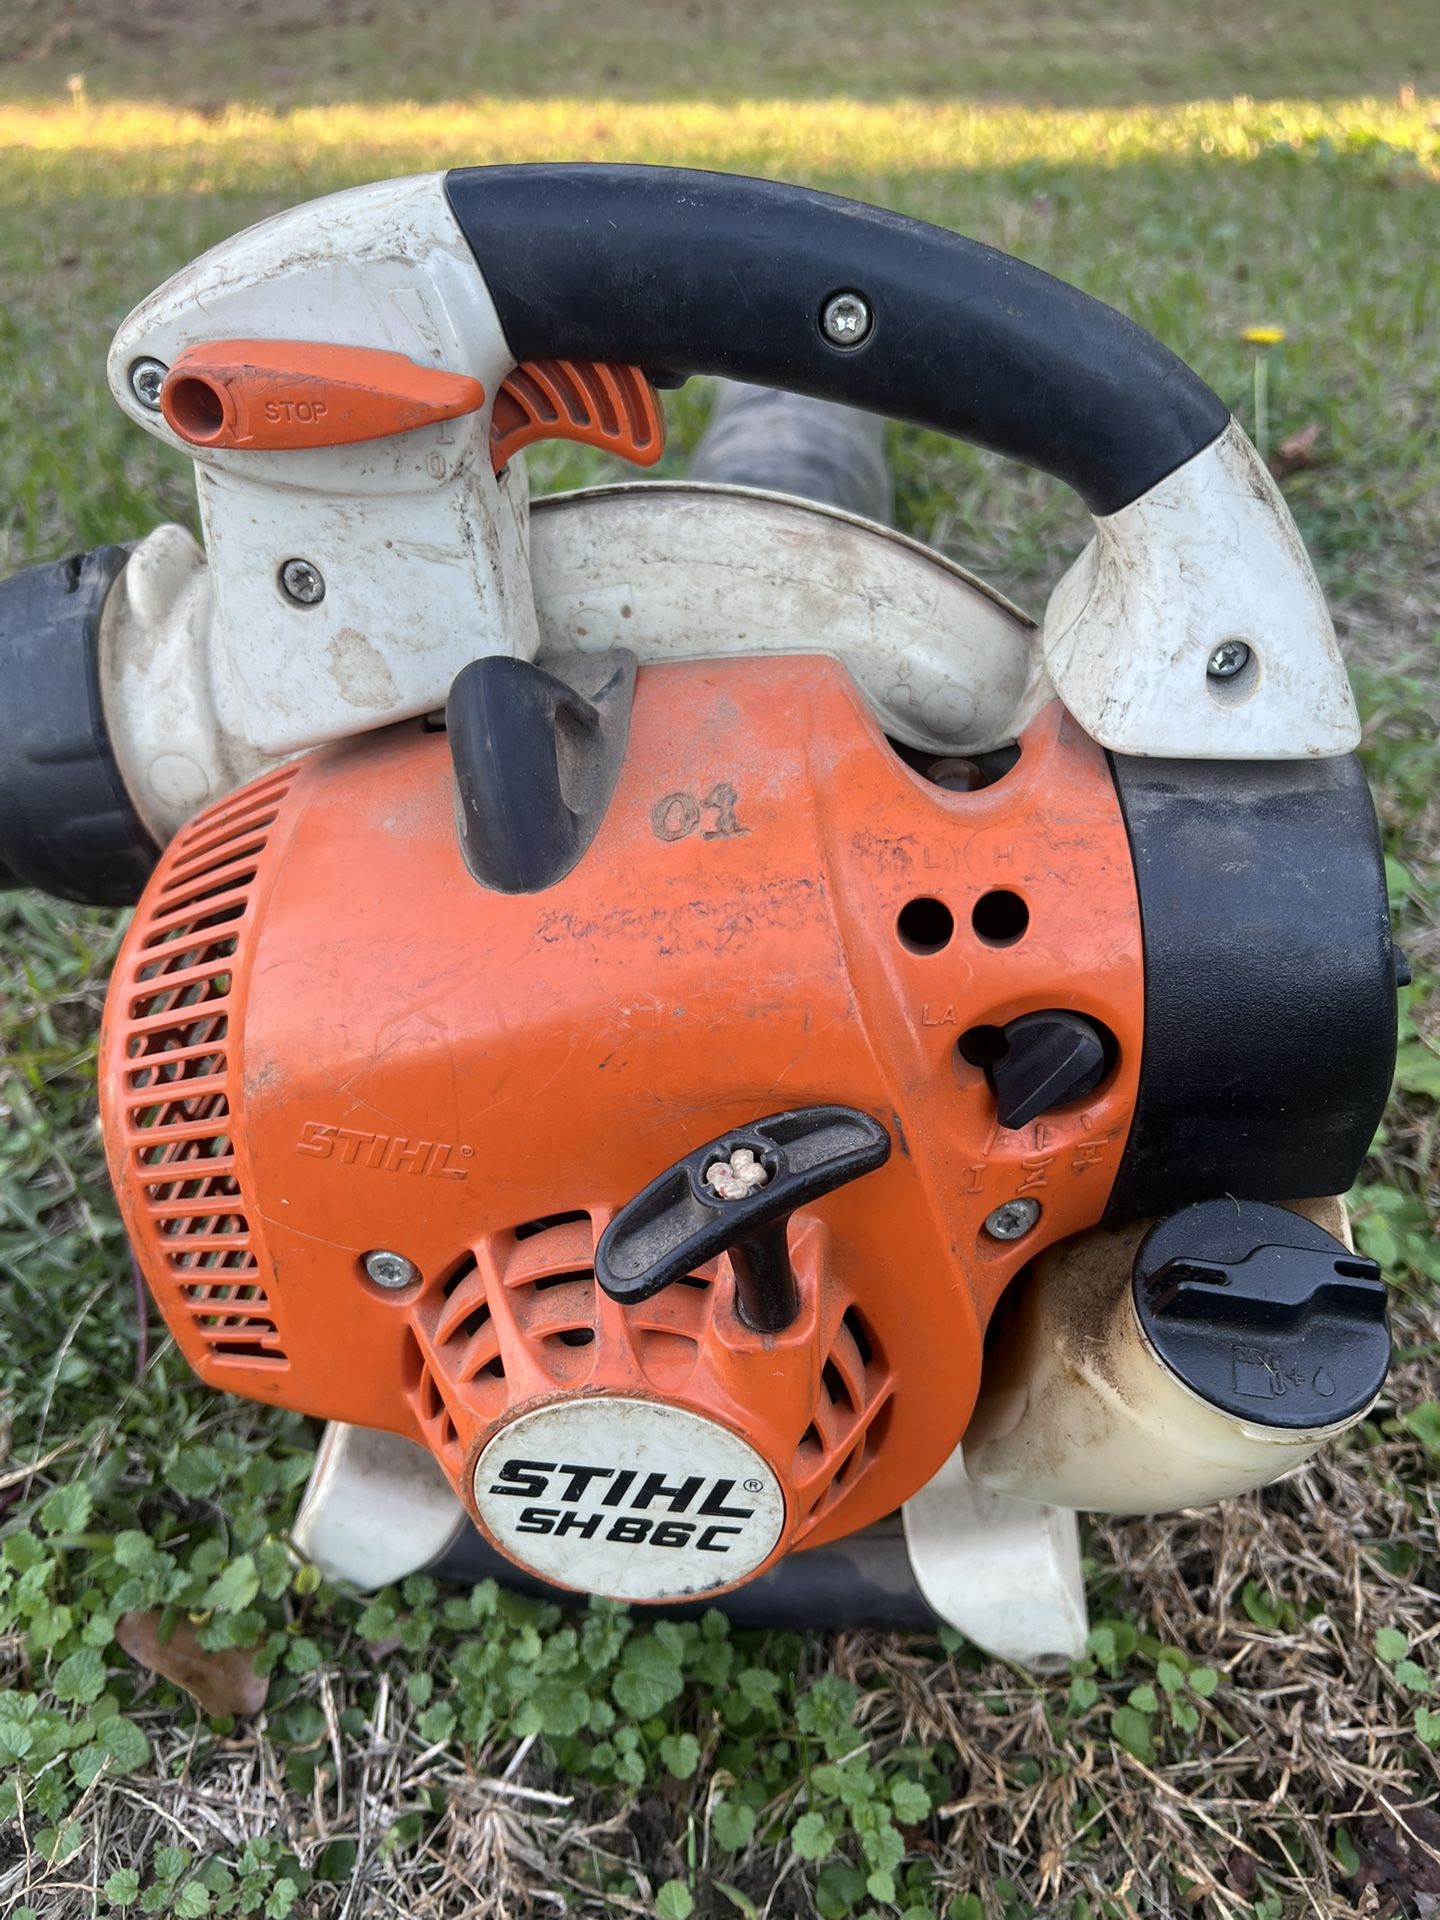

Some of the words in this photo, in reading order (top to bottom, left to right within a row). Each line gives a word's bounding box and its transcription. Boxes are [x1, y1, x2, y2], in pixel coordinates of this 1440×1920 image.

[264, 400, 329, 424] STOP
[652, 783, 752, 841] 01
[993, 845, 1014, 867] H
[921, 1004, 957, 1026] LA
